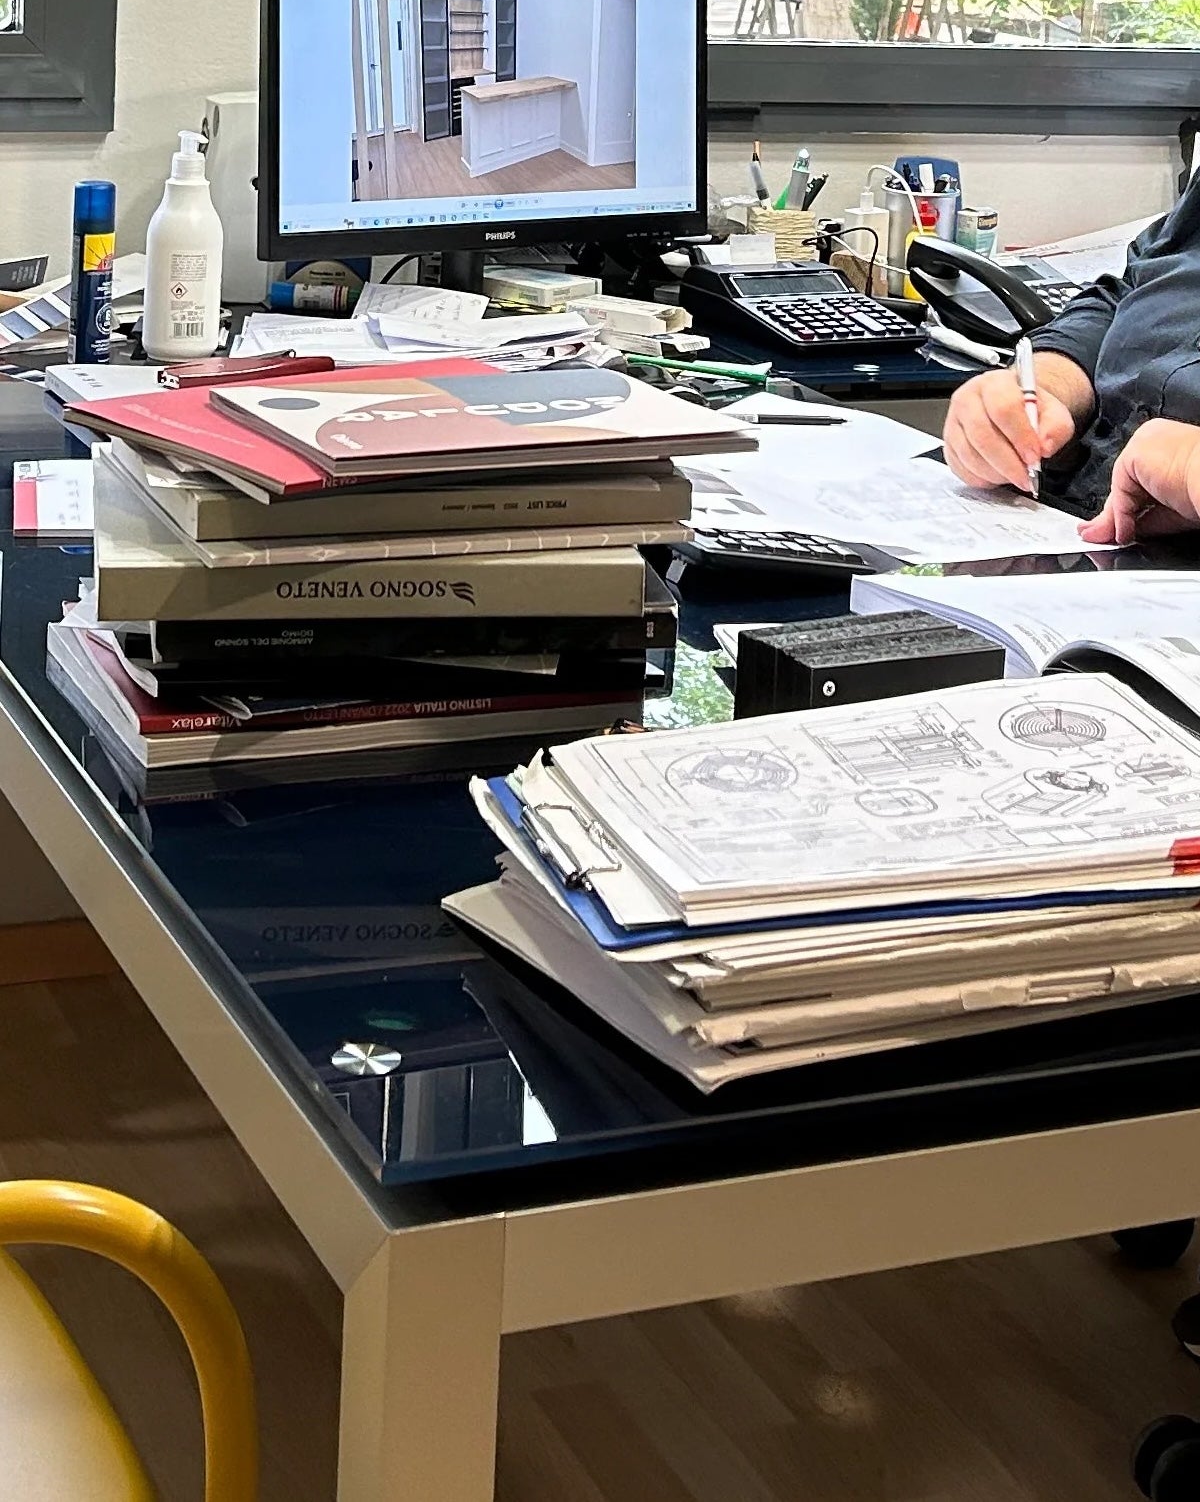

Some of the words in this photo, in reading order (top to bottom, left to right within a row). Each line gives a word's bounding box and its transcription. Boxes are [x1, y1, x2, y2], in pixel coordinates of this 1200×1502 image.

[485, 231, 516, 241] PHILIPS
[526, 499, 544, 510] LIST
[545, 499, 568, 510] PRICE
[276, 580, 364, 599] VENETO
[370, 580, 447, 598] SOGNO
[251, 638, 270, 646] DEL
[413, 701, 447, 713] ITALIA
[449, 698, 492, 710] LISTINO
[171, 714, 242, 729] Vitarelax
